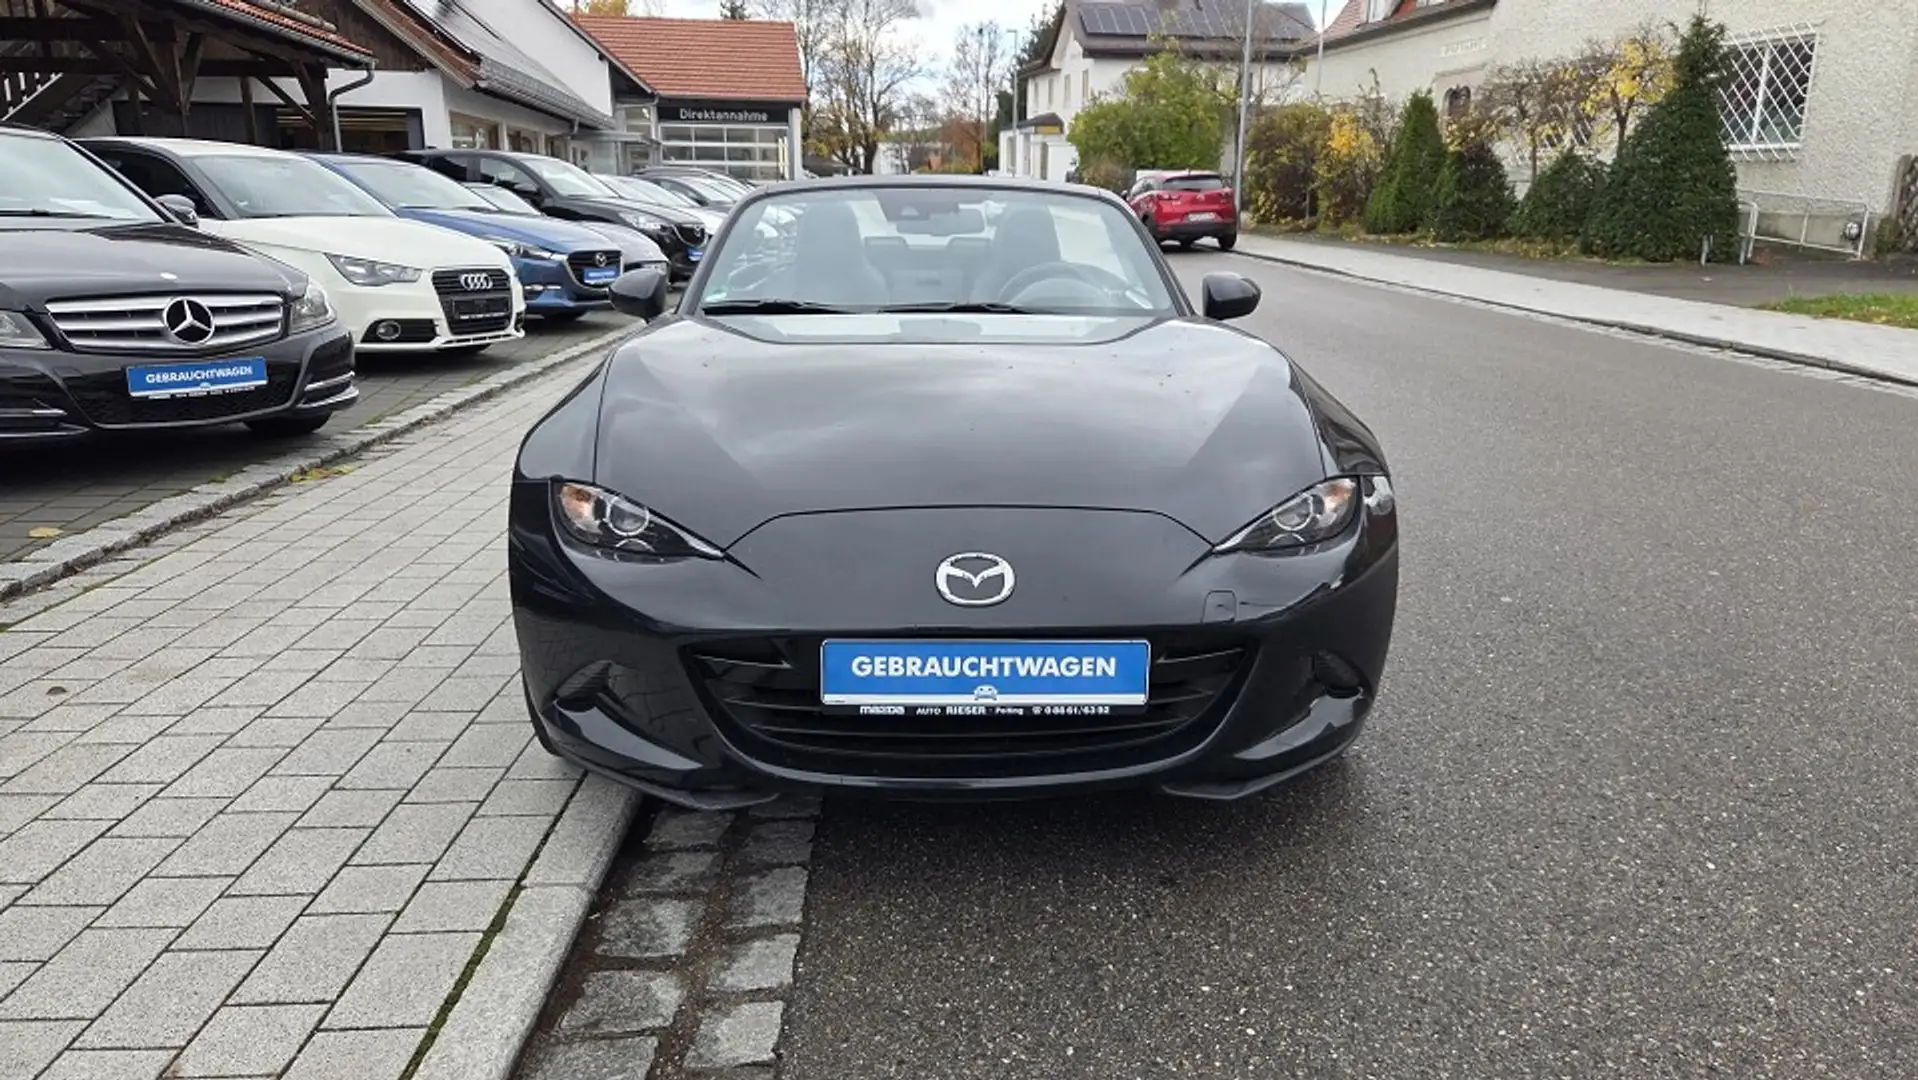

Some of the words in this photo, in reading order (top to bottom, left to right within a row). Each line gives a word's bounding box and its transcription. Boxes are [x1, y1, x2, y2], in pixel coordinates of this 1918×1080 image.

[680, 108, 769, 121] Direktannahme
[145, 365, 254, 384] GEBRAUCHTWAGEN
[851, 656, 1116, 678] GEBRAUCHTWAGEN
[916, 707, 942, 715] AUTO
[946, 705, 986, 715] RIESER
